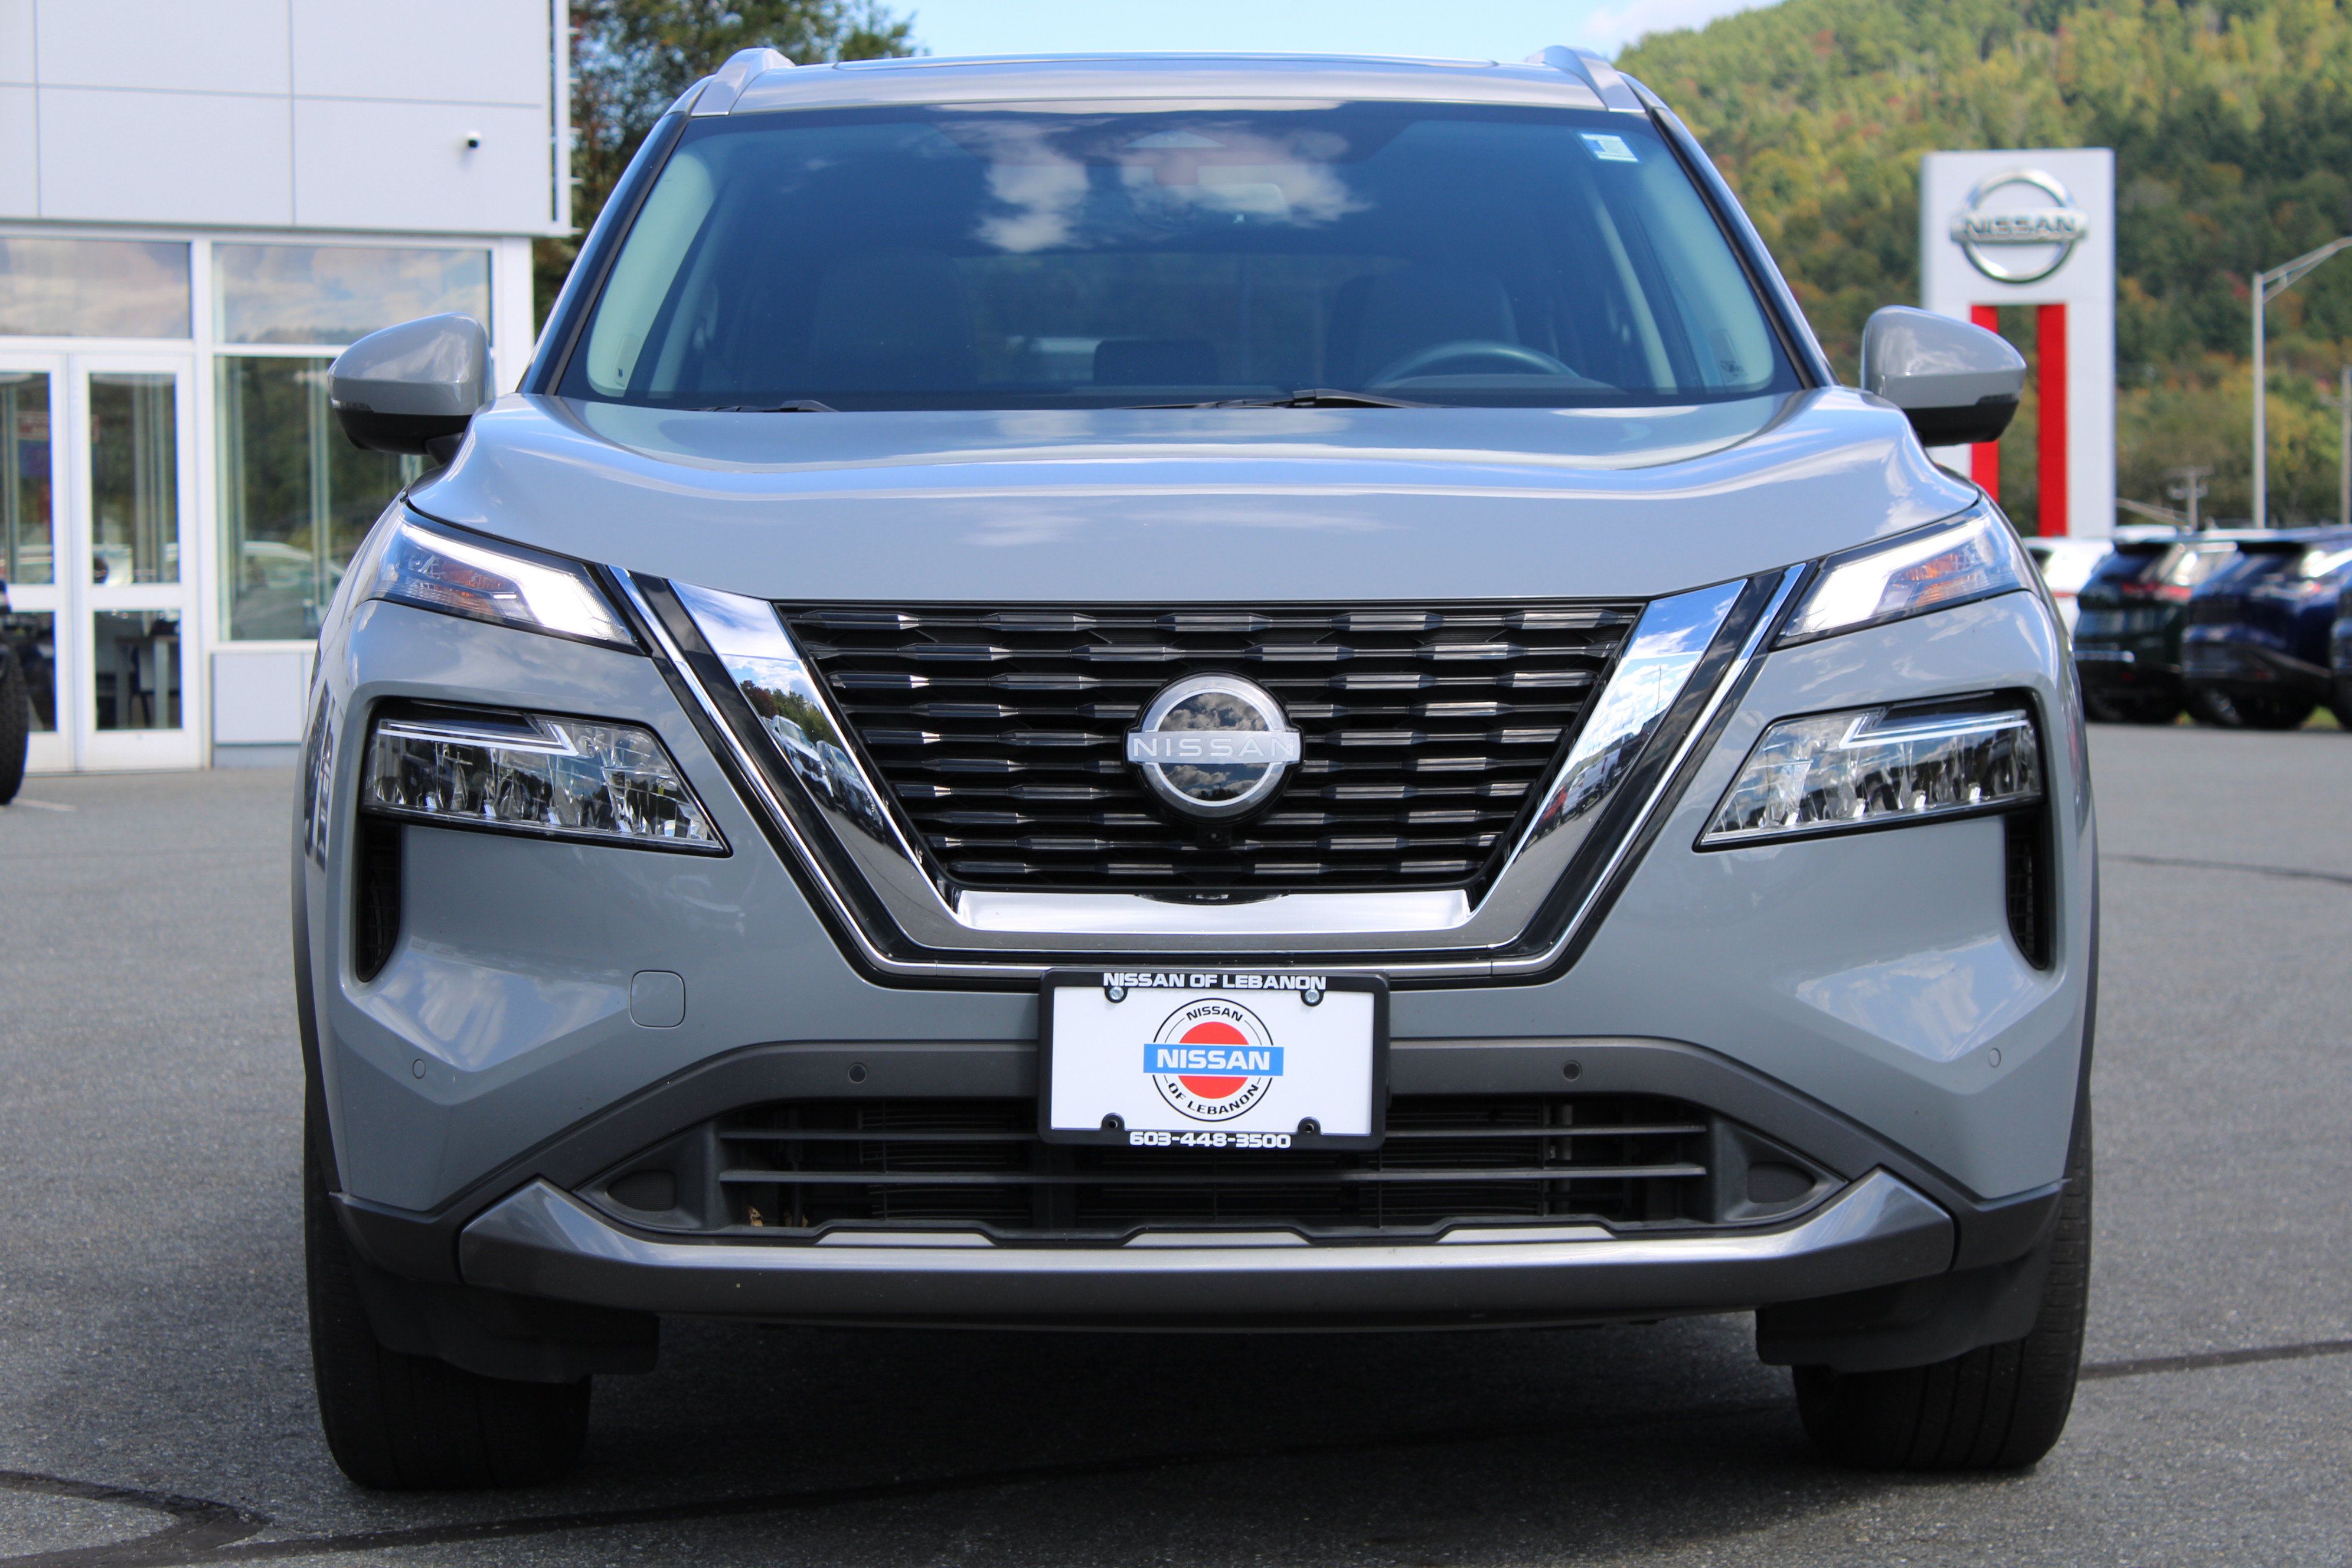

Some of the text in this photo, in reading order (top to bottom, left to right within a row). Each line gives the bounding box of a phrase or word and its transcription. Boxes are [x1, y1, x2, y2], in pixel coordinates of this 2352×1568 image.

[1965, 217, 2075, 234] NISSAN
[1133, 738, 1294, 757] NISSAN
[1103, 972, 1327, 990] NISSAN OF LEBANON
[1186, 1006, 1243, 1021] NISSAN
[1157, 1048, 1270, 1070] NISSAN
[1168, 1082, 1259, 1115] OF LEBANON
[1129, 1131, 1292, 1149] 603-448-3500
